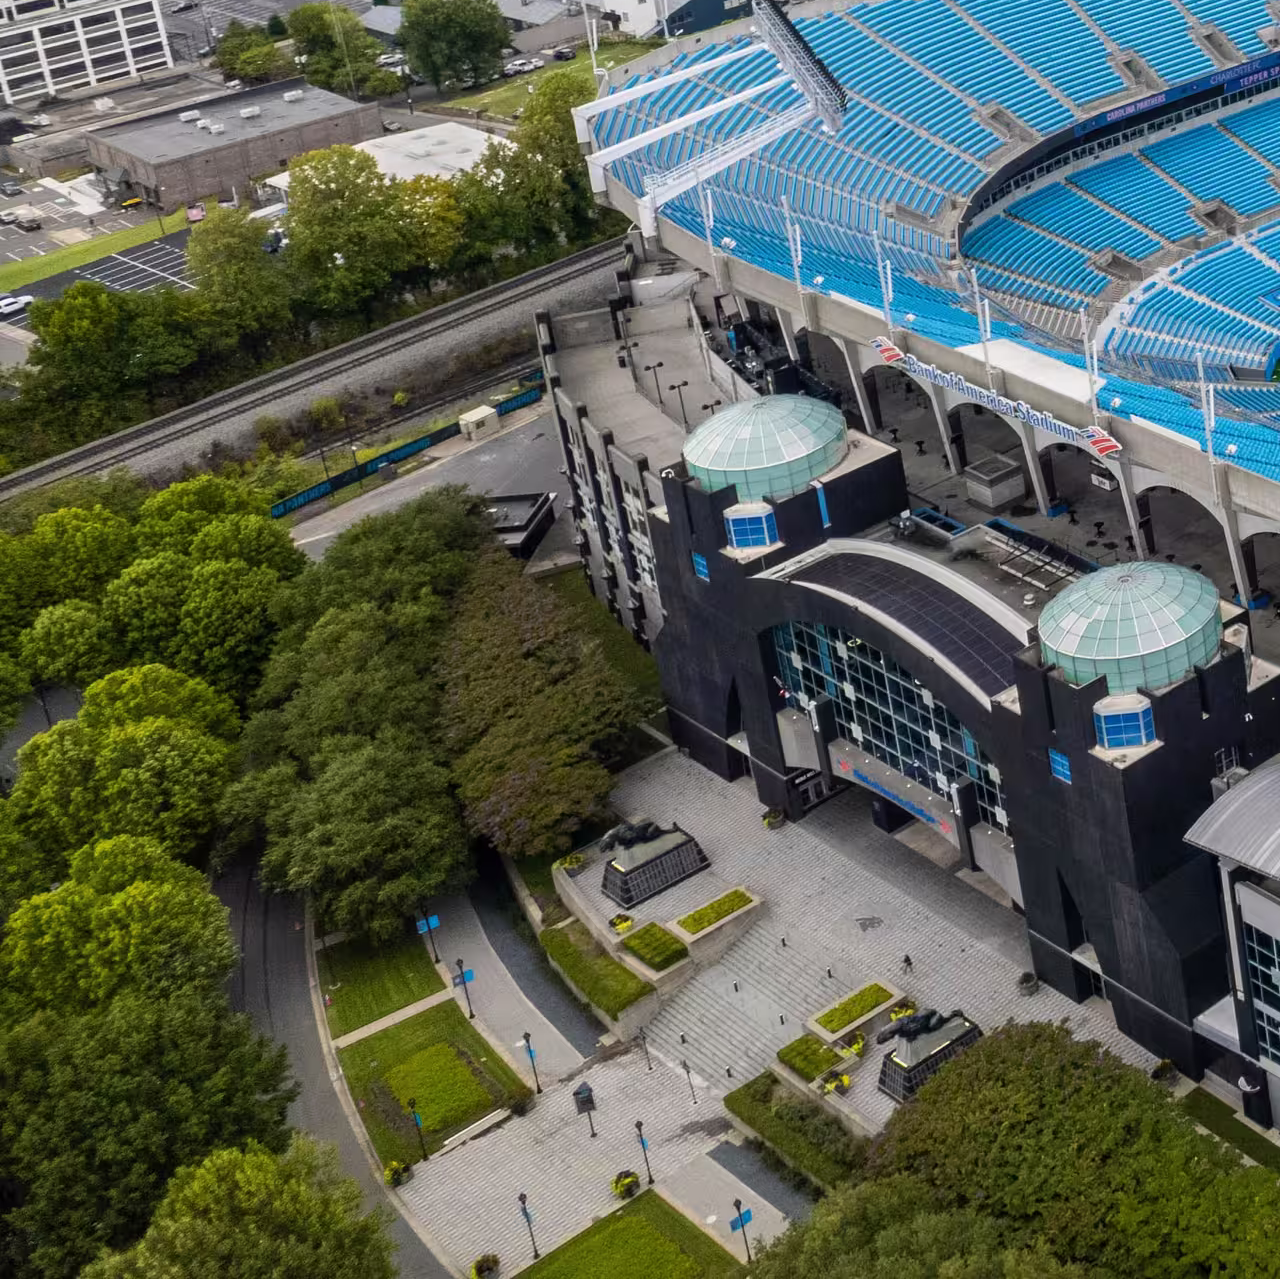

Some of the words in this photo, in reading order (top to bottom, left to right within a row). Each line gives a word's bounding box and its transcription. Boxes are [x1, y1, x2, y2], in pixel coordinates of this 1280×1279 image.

[1240, 72, 1268, 87] TEPPER
[905, 353, 942, 386] Bank
[941, 371, 957, 391] of
[956, 374, 1016, 418] America
[1015, 399, 1079, 442] Stadium
